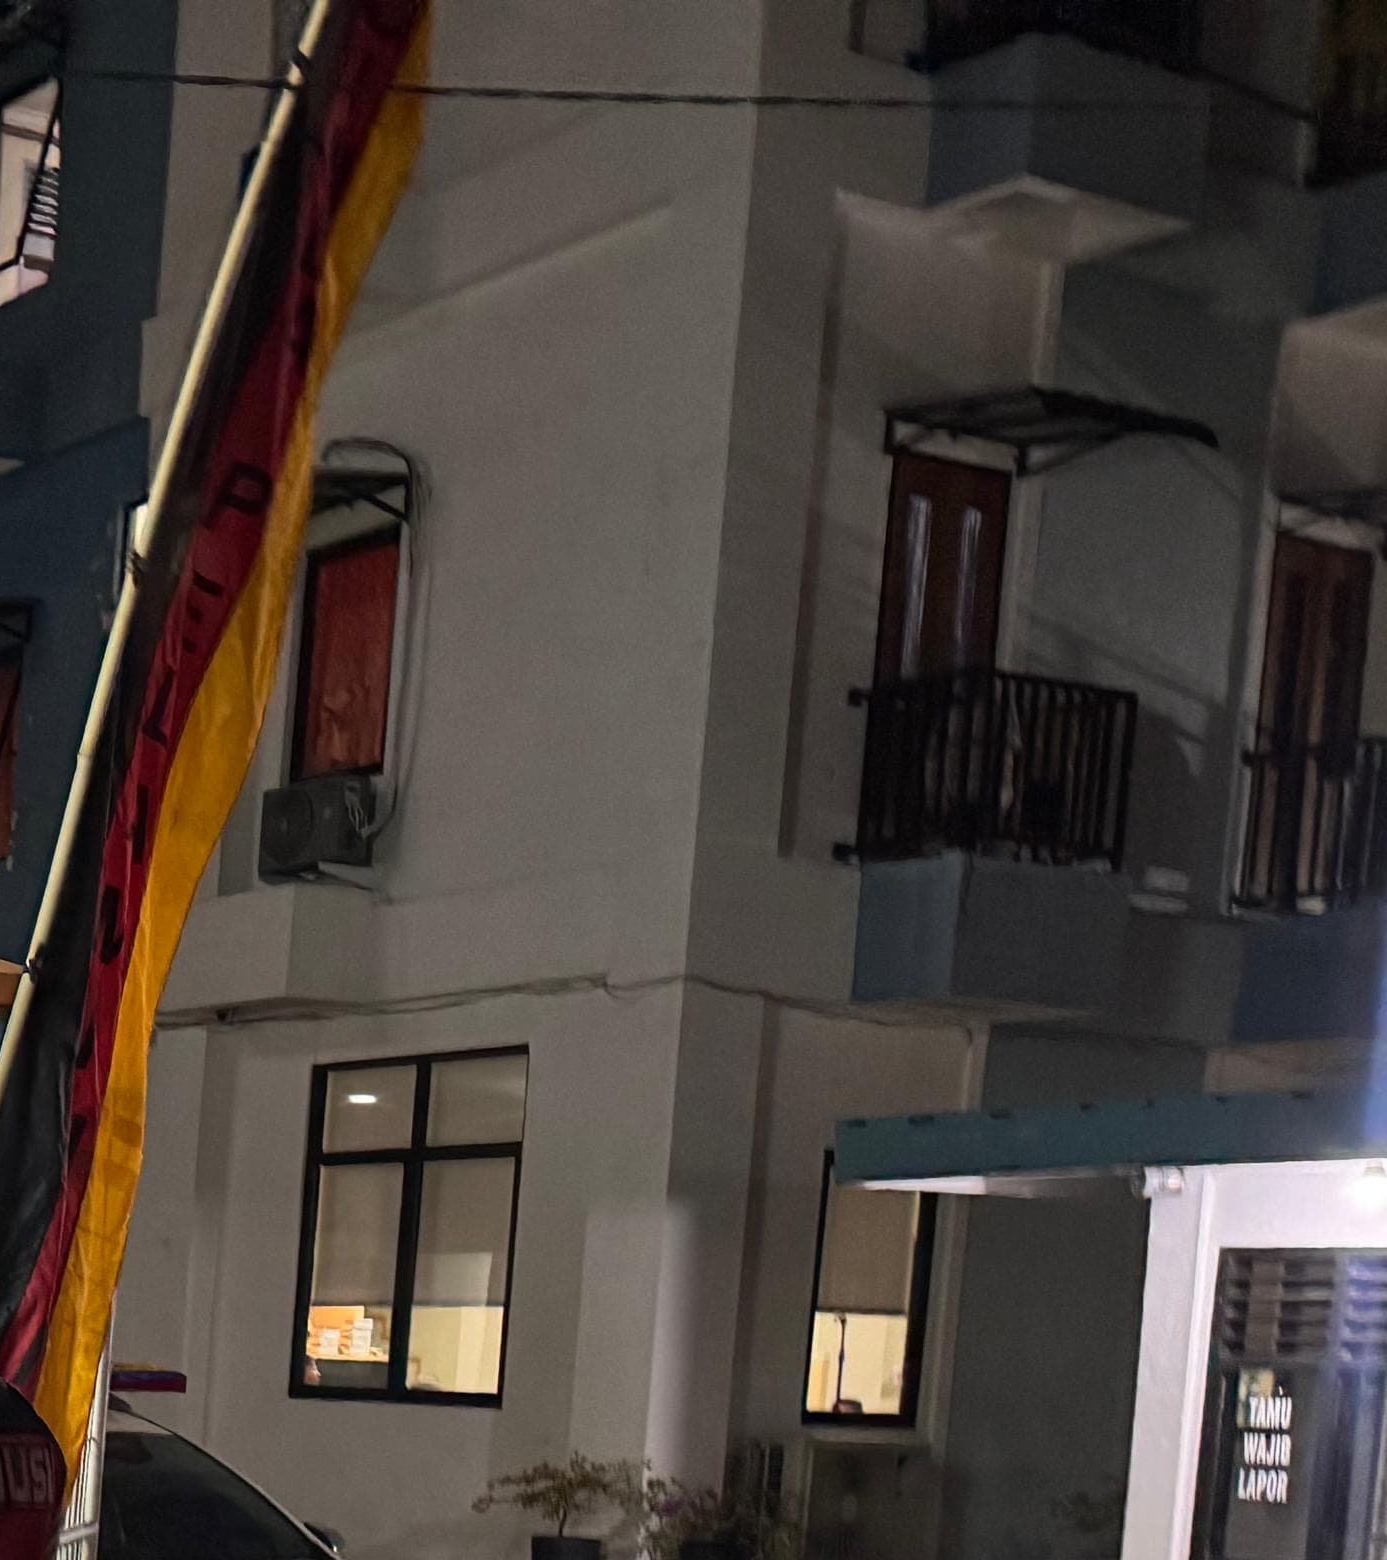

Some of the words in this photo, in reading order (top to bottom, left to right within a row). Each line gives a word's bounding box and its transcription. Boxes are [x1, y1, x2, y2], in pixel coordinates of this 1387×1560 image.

[1249, 1396, 1292, 1430] TAMU
[1243, 1432, 1292, 1467] WAJIB
[1237, 1467, 1289, 1505] LAPOR
